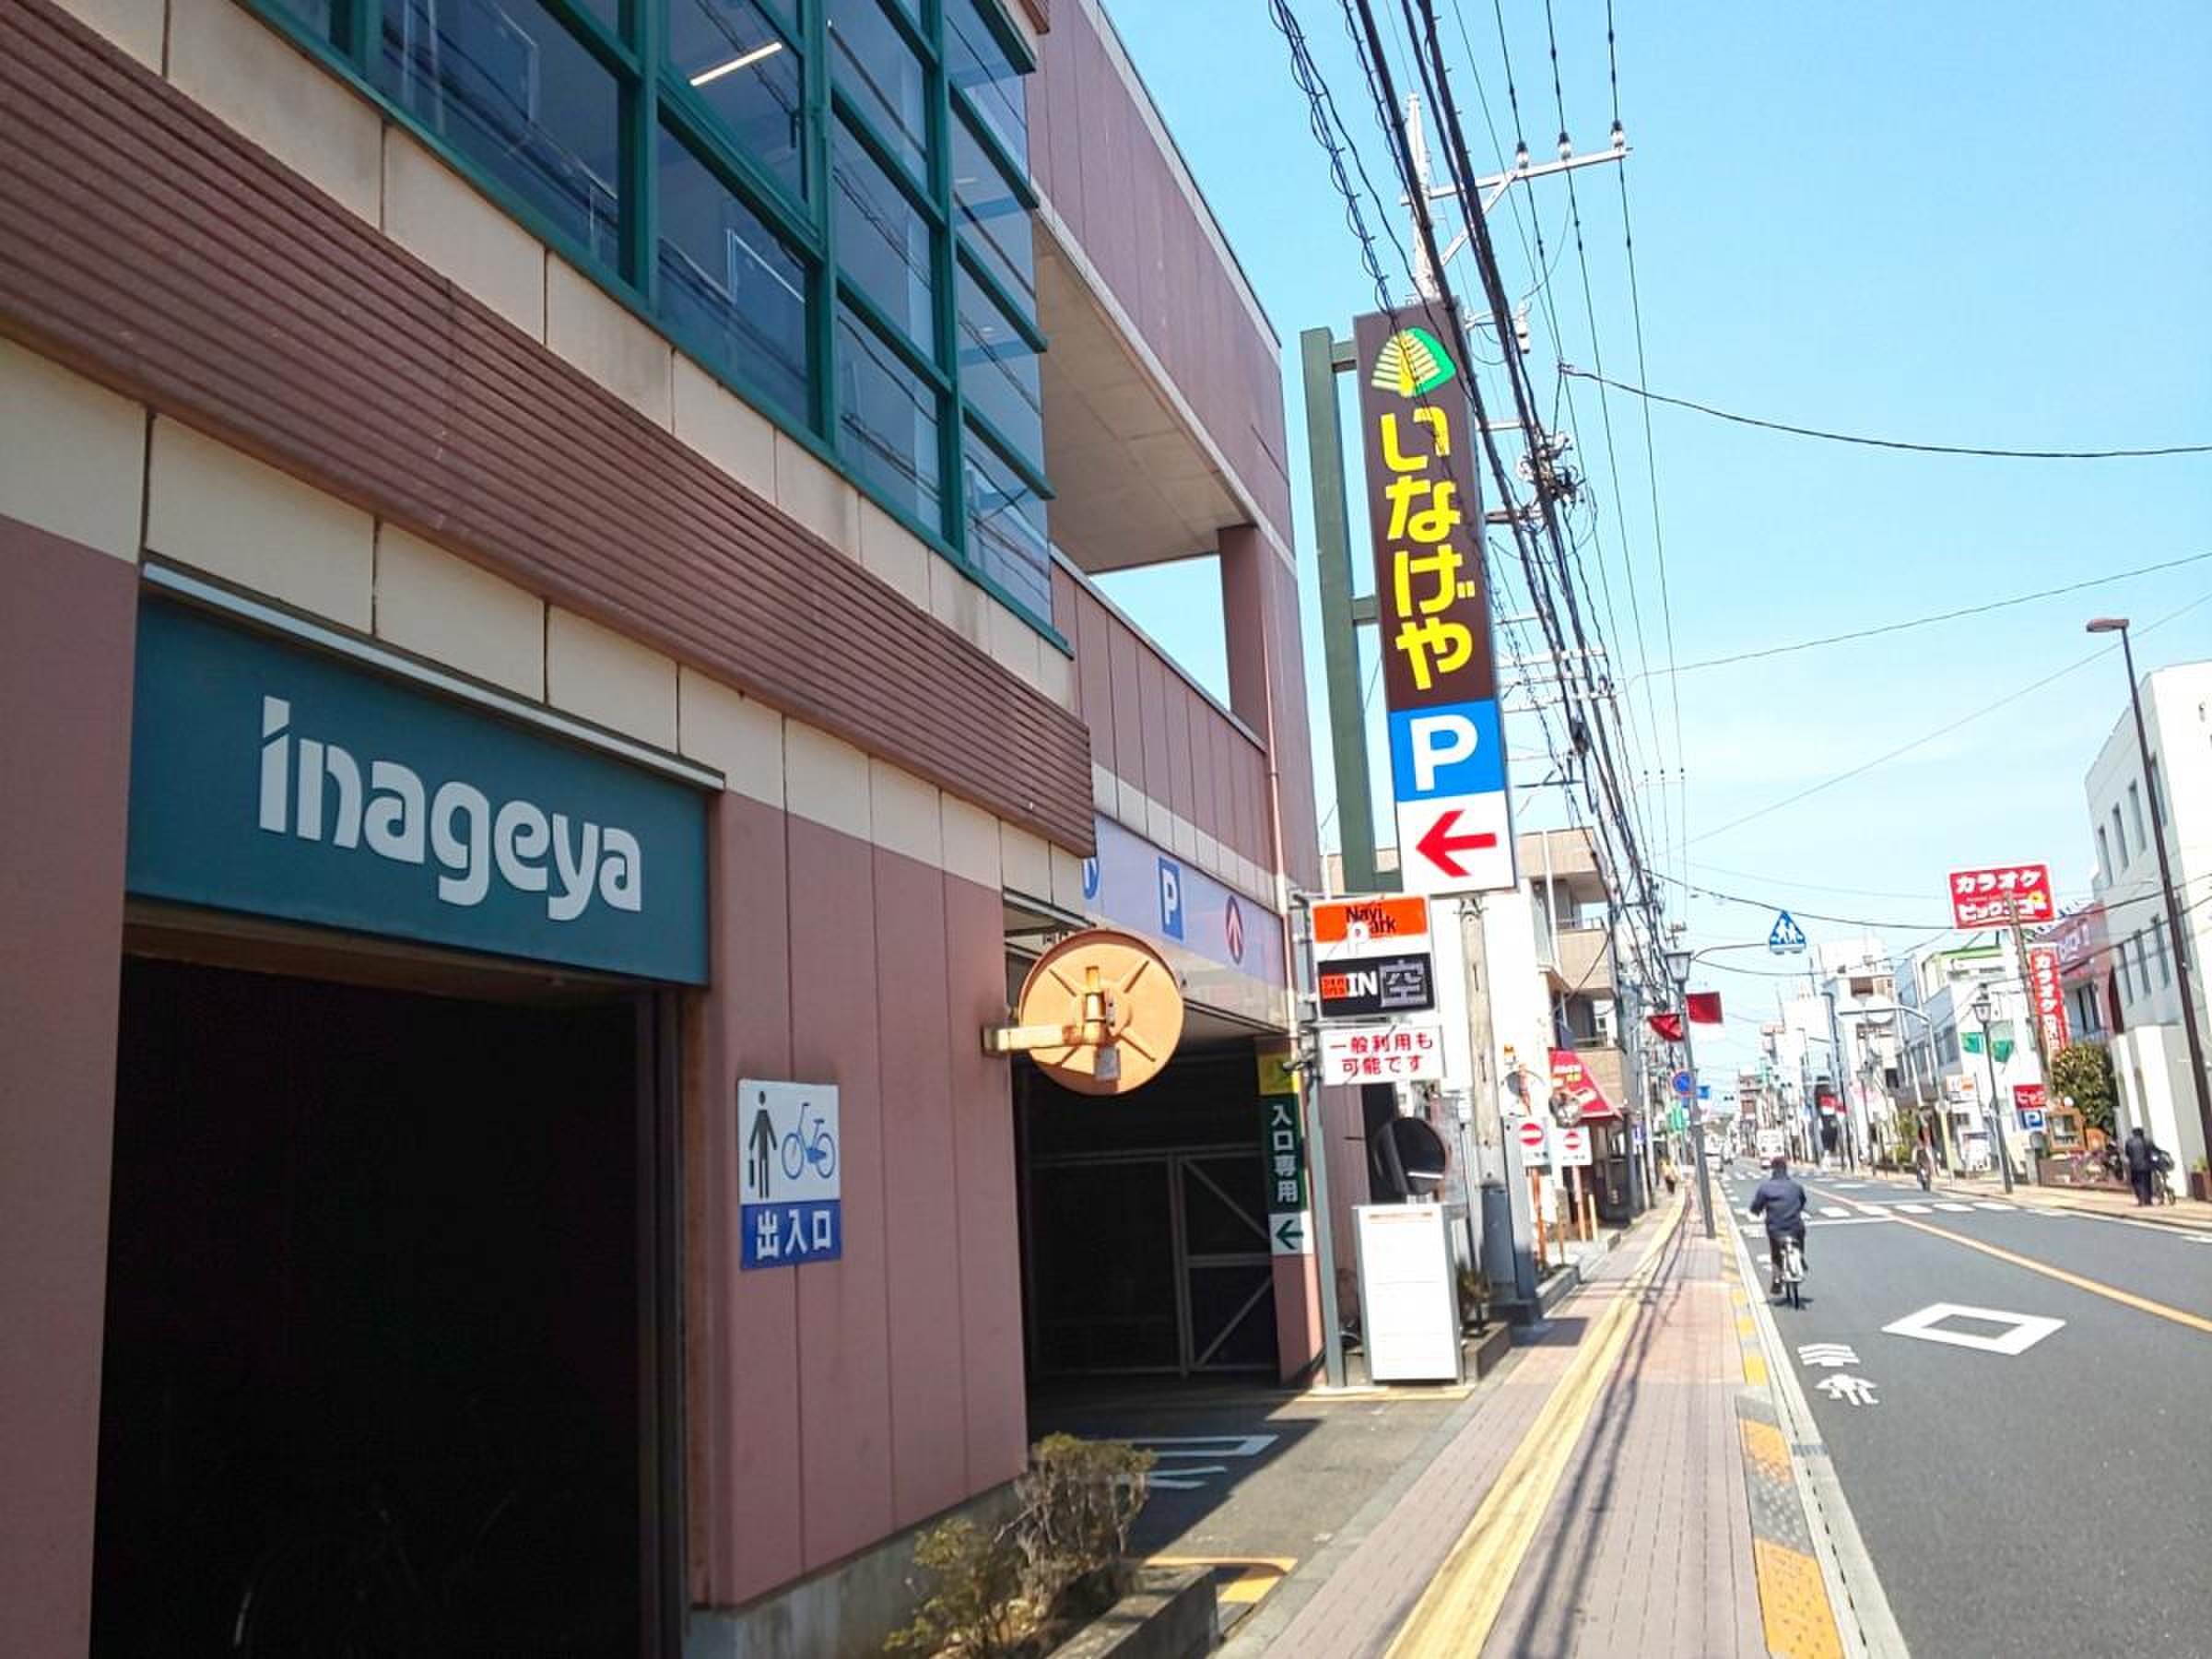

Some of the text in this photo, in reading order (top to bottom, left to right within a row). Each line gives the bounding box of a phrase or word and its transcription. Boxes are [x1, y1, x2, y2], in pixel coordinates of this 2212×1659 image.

[1381, 406, 1475, 690] いなげや
[1410, 714, 1478, 792] P
[259, 695, 641, 921] inageya
[1160, 865, 1178, 924] P
[1957, 870, 2041, 893] カラオケ
[1346, 902, 1382, 923] Navi
[1329, 1032, 1432, 1053] 一般利用も
[1341, 1054, 1423, 1077] 可能です
[1270, 1104, 1299, 1204] 入口専用
[756, 1208, 832, 1260] 出入口
